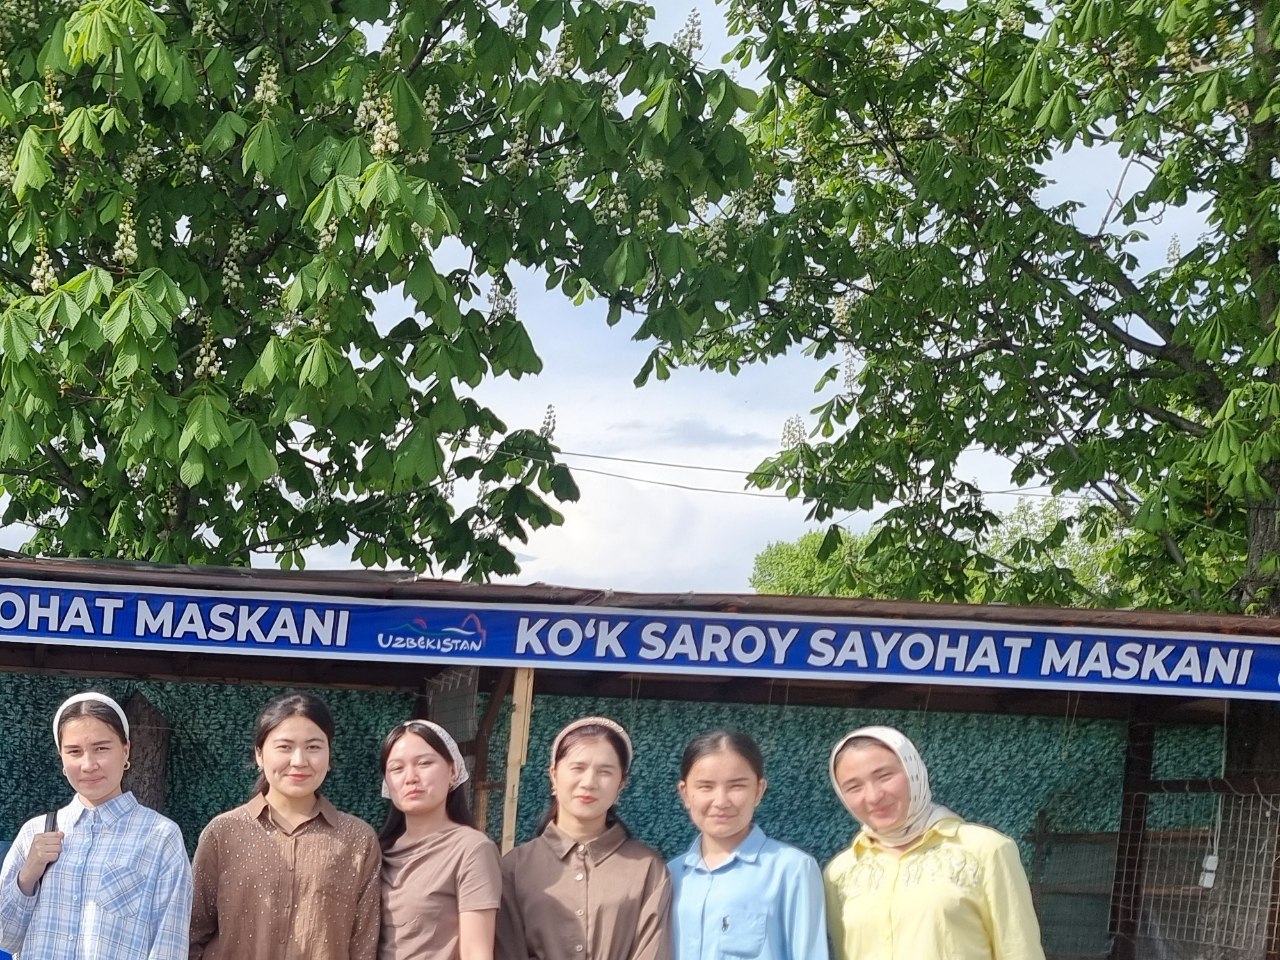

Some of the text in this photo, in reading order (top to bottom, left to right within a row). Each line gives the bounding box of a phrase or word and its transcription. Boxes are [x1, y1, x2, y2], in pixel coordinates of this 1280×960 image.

[135, 601, 349, 646] MASKANI
[377, 633, 482, 653] UZBEKISTAN
[638, 622, 800, 664] SAROY
[806, 629, 1032, 674] SAYOHAT
[1040, 640, 1254, 685] MASKANI
